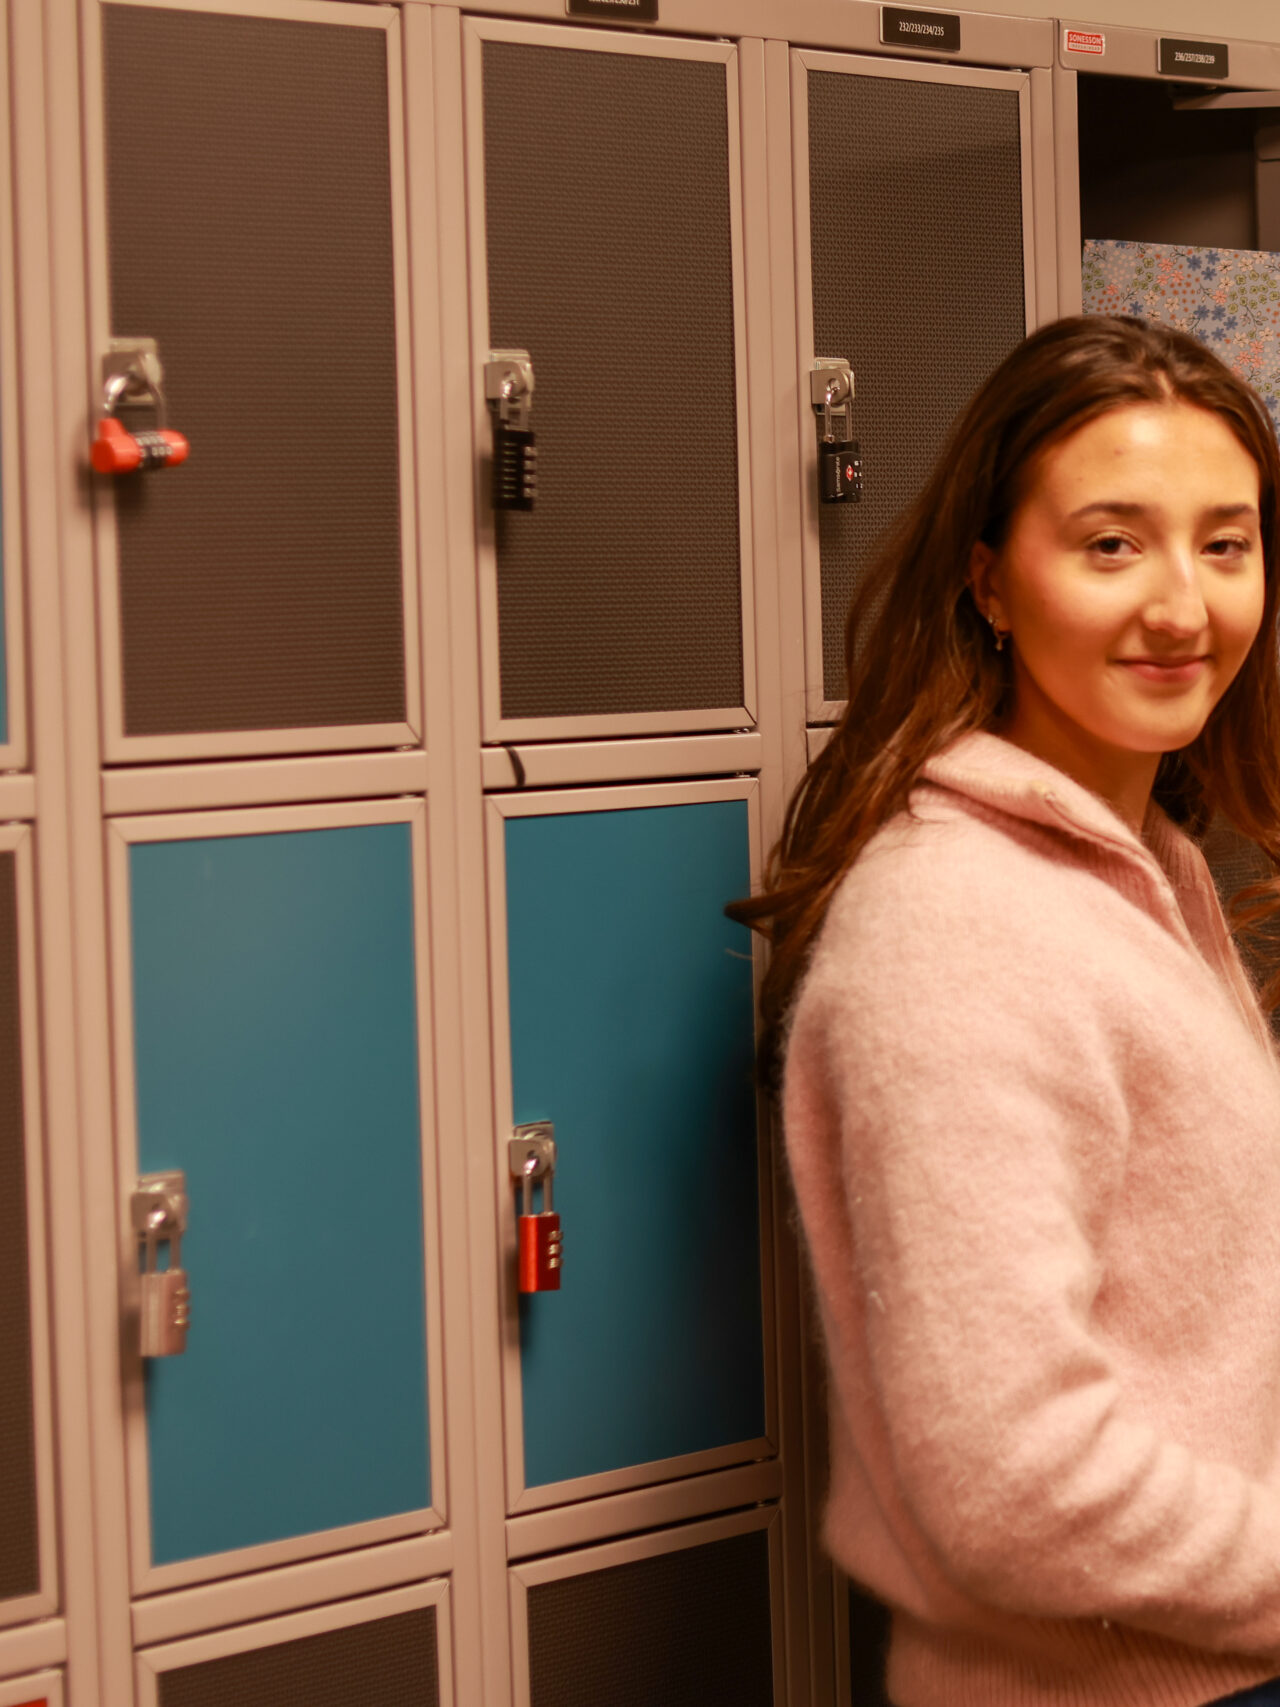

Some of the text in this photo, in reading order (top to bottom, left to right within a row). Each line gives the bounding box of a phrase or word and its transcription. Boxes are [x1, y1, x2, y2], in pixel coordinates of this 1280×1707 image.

[898, 20, 945, 37] 232/233/234/235
[1069, 33, 1102, 45] SONESSON
[1174, 51, 1215, 65] 236/237/238/239
